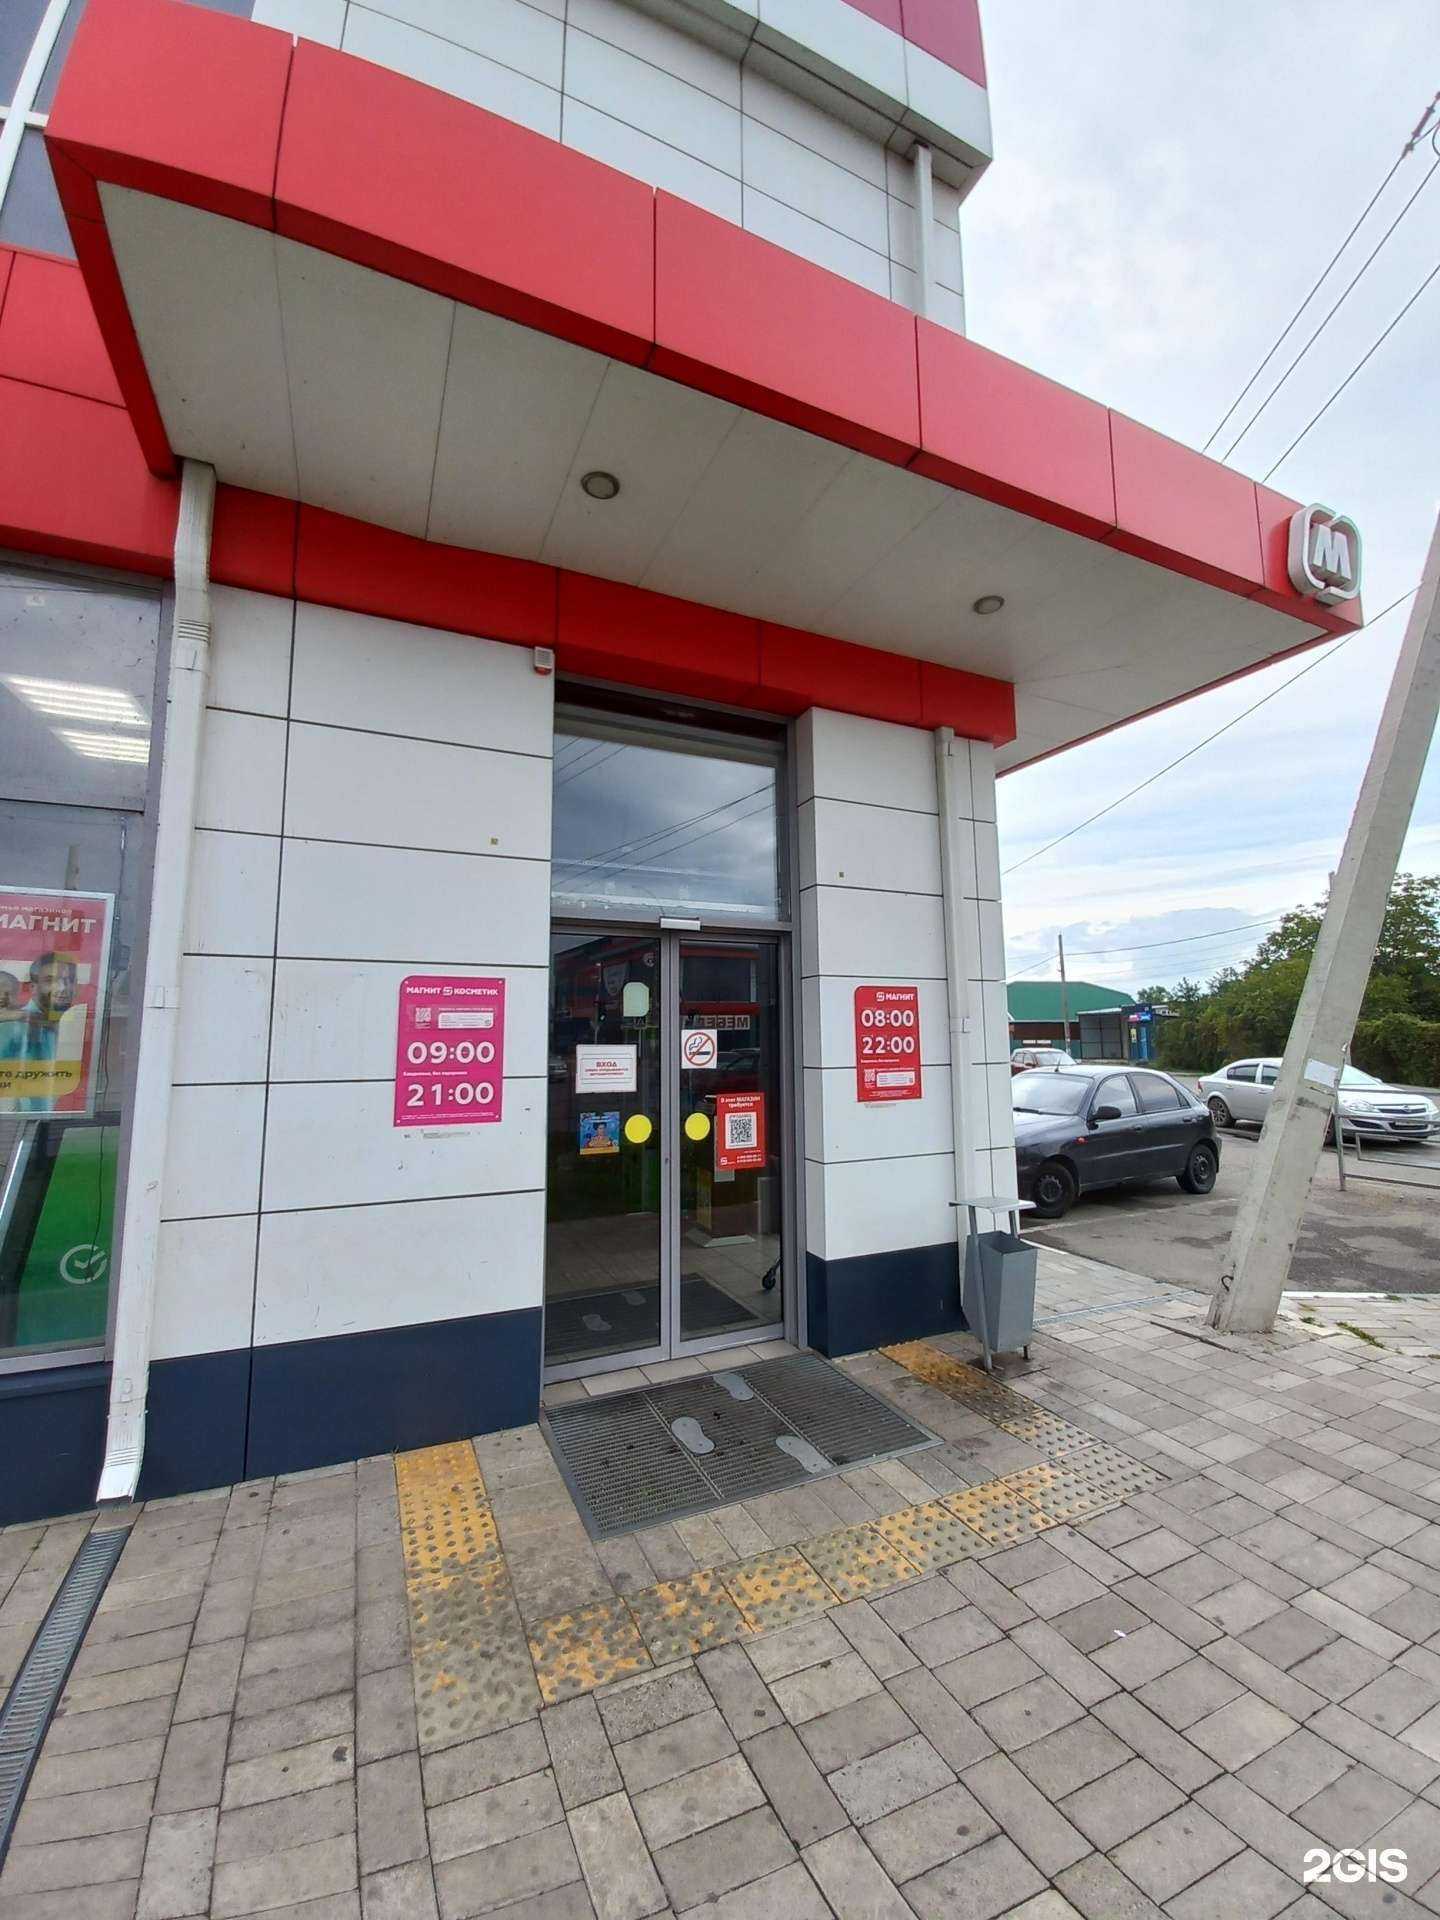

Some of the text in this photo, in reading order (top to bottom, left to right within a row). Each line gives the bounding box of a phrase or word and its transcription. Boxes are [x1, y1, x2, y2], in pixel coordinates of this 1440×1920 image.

[406, 986, 499, 996] МАГНИТ КОСМЕТИК
[885, 993, 915, 1001] МАГНИТ
[861, 1009, 915, 1027] 08:00
[407, 1041, 496, 1064] 09:00
[862, 1036, 915, 1054] 22:00
[15, 1071, 73, 1079] дружить
[407, 1082, 495, 1107] 21:00
